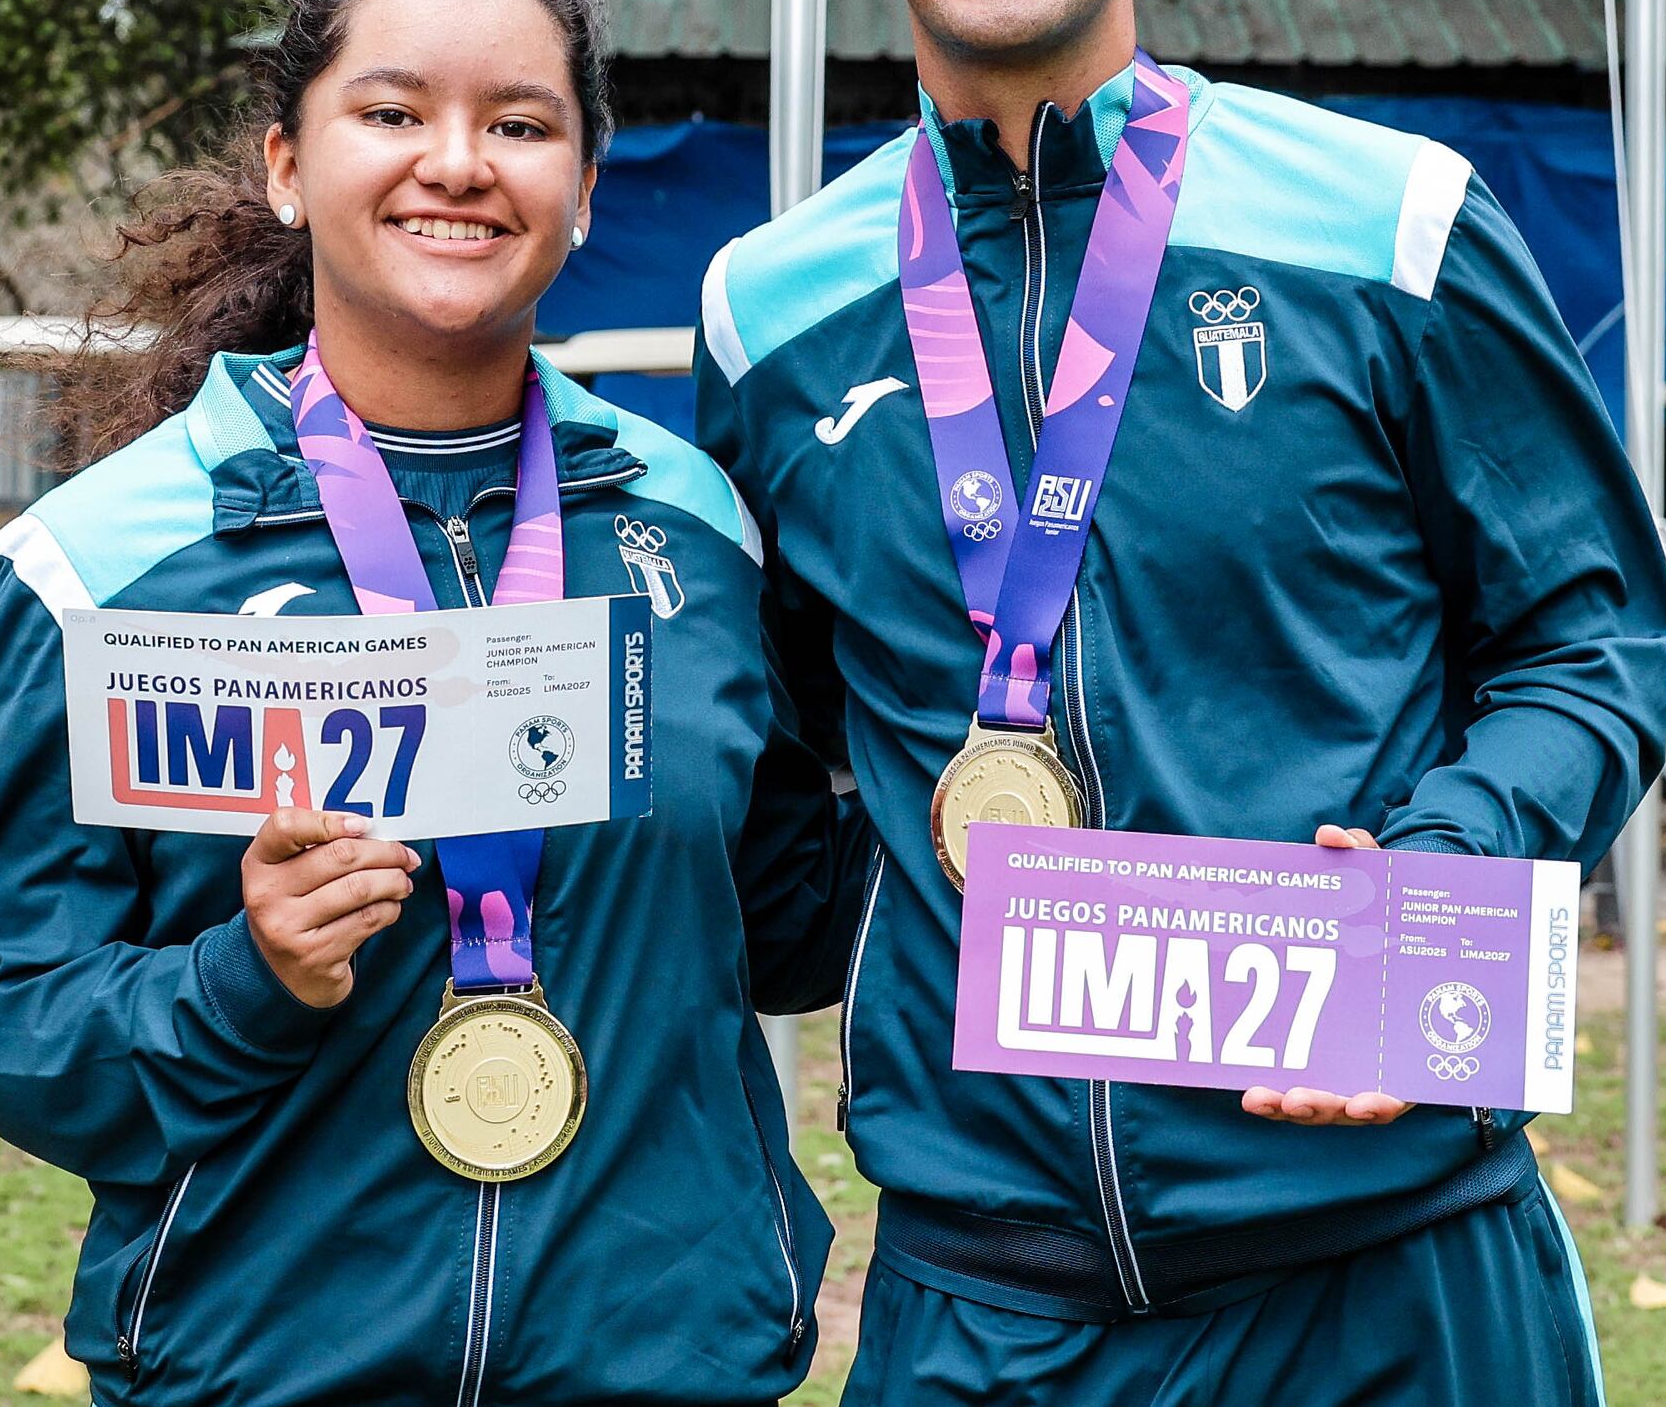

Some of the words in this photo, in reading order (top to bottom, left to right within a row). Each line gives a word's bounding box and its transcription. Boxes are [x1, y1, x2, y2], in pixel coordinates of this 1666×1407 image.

[1198, 325, 1261, 342] GUATEMALA
[103, 633, 195, 650] QUALIFIED
[199, 638, 222, 651] TO
[227, 639, 262, 653] PAN
[267, 640, 360, 654] AMERICAN
[365, 636, 427, 652] GAMES
[486, 634, 532, 644] Passenger:
[486, 647, 521, 658] JUNIOR
[524, 645, 543, 655] PAN
[545, 641, 596, 653] AMERICAN
[486, 657, 538, 669] CHAMPION
[625, 631, 644, 708] SPORTS
[106, 672, 202, 695] JUEGOS
[214, 677, 428, 700] PANAMERICANOS
[486, 679, 511, 687] From:
[543, 674, 555, 682] To:
[486, 686, 532, 698] ASU2025
[543, 681, 591, 693] LIMA2027
[516, 717, 541, 738] PANAM
[541, 716, 568, 734] SPORTS
[960, 738, 1010, 762] PANAMERICANOS
[1012, 738, 1036, 751] JUNIOR
[516, 759, 568, 778] ORGANIZATION
[1007, 853, 1104, 874] QUALIFIED
[1107, 860, 1132, 875] TO
[1136, 862, 1173, 879] PAN
[1176, 864, 1273, 886] AMERICAN
[1277, 872, 1342, 891] GAMES
[1402, 887, 1451, 899] Passenger:
[1401, 901, 1439, 914] JUNIOR
[1441, 903, 1462, 914] PAN
[1464, 906, 1518, 919] AMERICAN
[1004, 897, 1107, 925] JUEGOS
[1117, 904, 1340, 942] PANAMERICANOS
[1400, 913, 1457, 926] CHAMPION
[1399, 933, 1426, 943] From:
[1460, 938, 1474, 947] To:
[1399, 945, 1447, 957] ASU2025
[1460, 950, 1511, 962] LIMA2027
[1547, 907, 1569, 989] SPORTS
[1427, 984, 1456, 1003] PANAM
[1456, 984, 1485, 1007] SPORTS
[1427, 1030, 1482, 1052] ORGANIZATION
